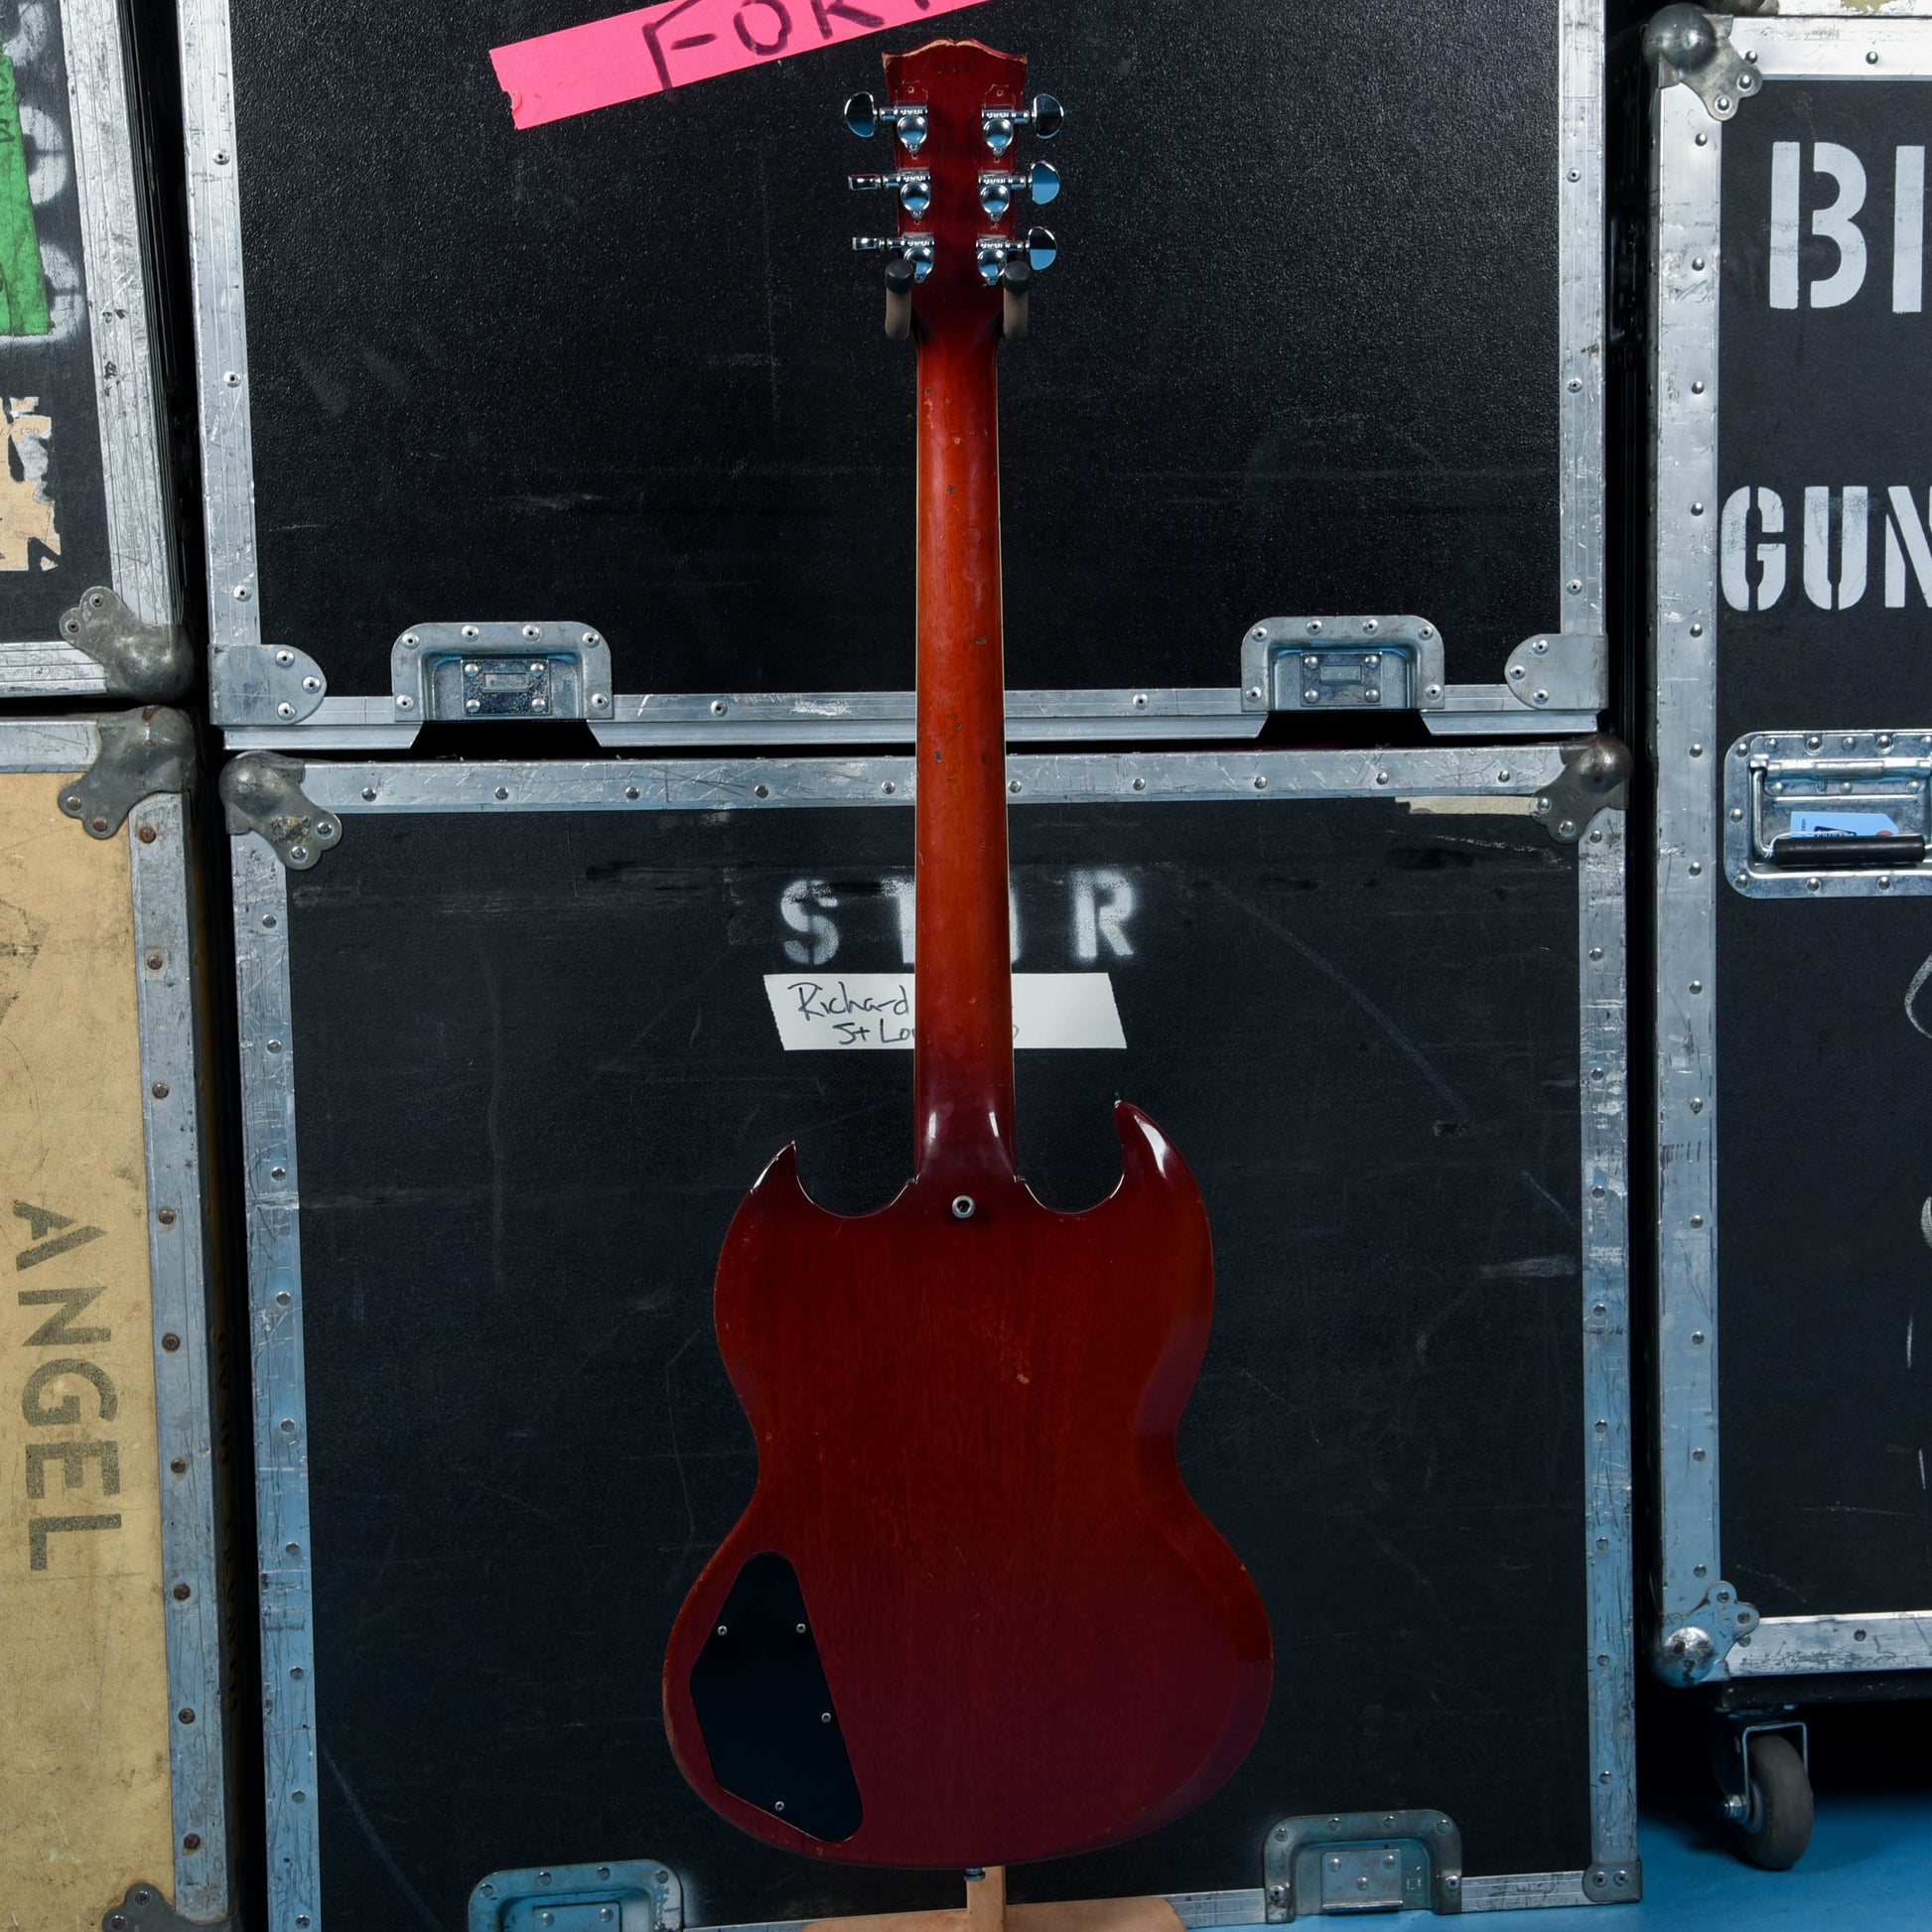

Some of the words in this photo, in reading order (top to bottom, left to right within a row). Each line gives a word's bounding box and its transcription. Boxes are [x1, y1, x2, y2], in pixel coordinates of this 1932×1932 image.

[787, 981, 909, 1021] Richard
[833, 1023, 871, 1043] St
[13, 1199, 122, 1571] ANGEL
